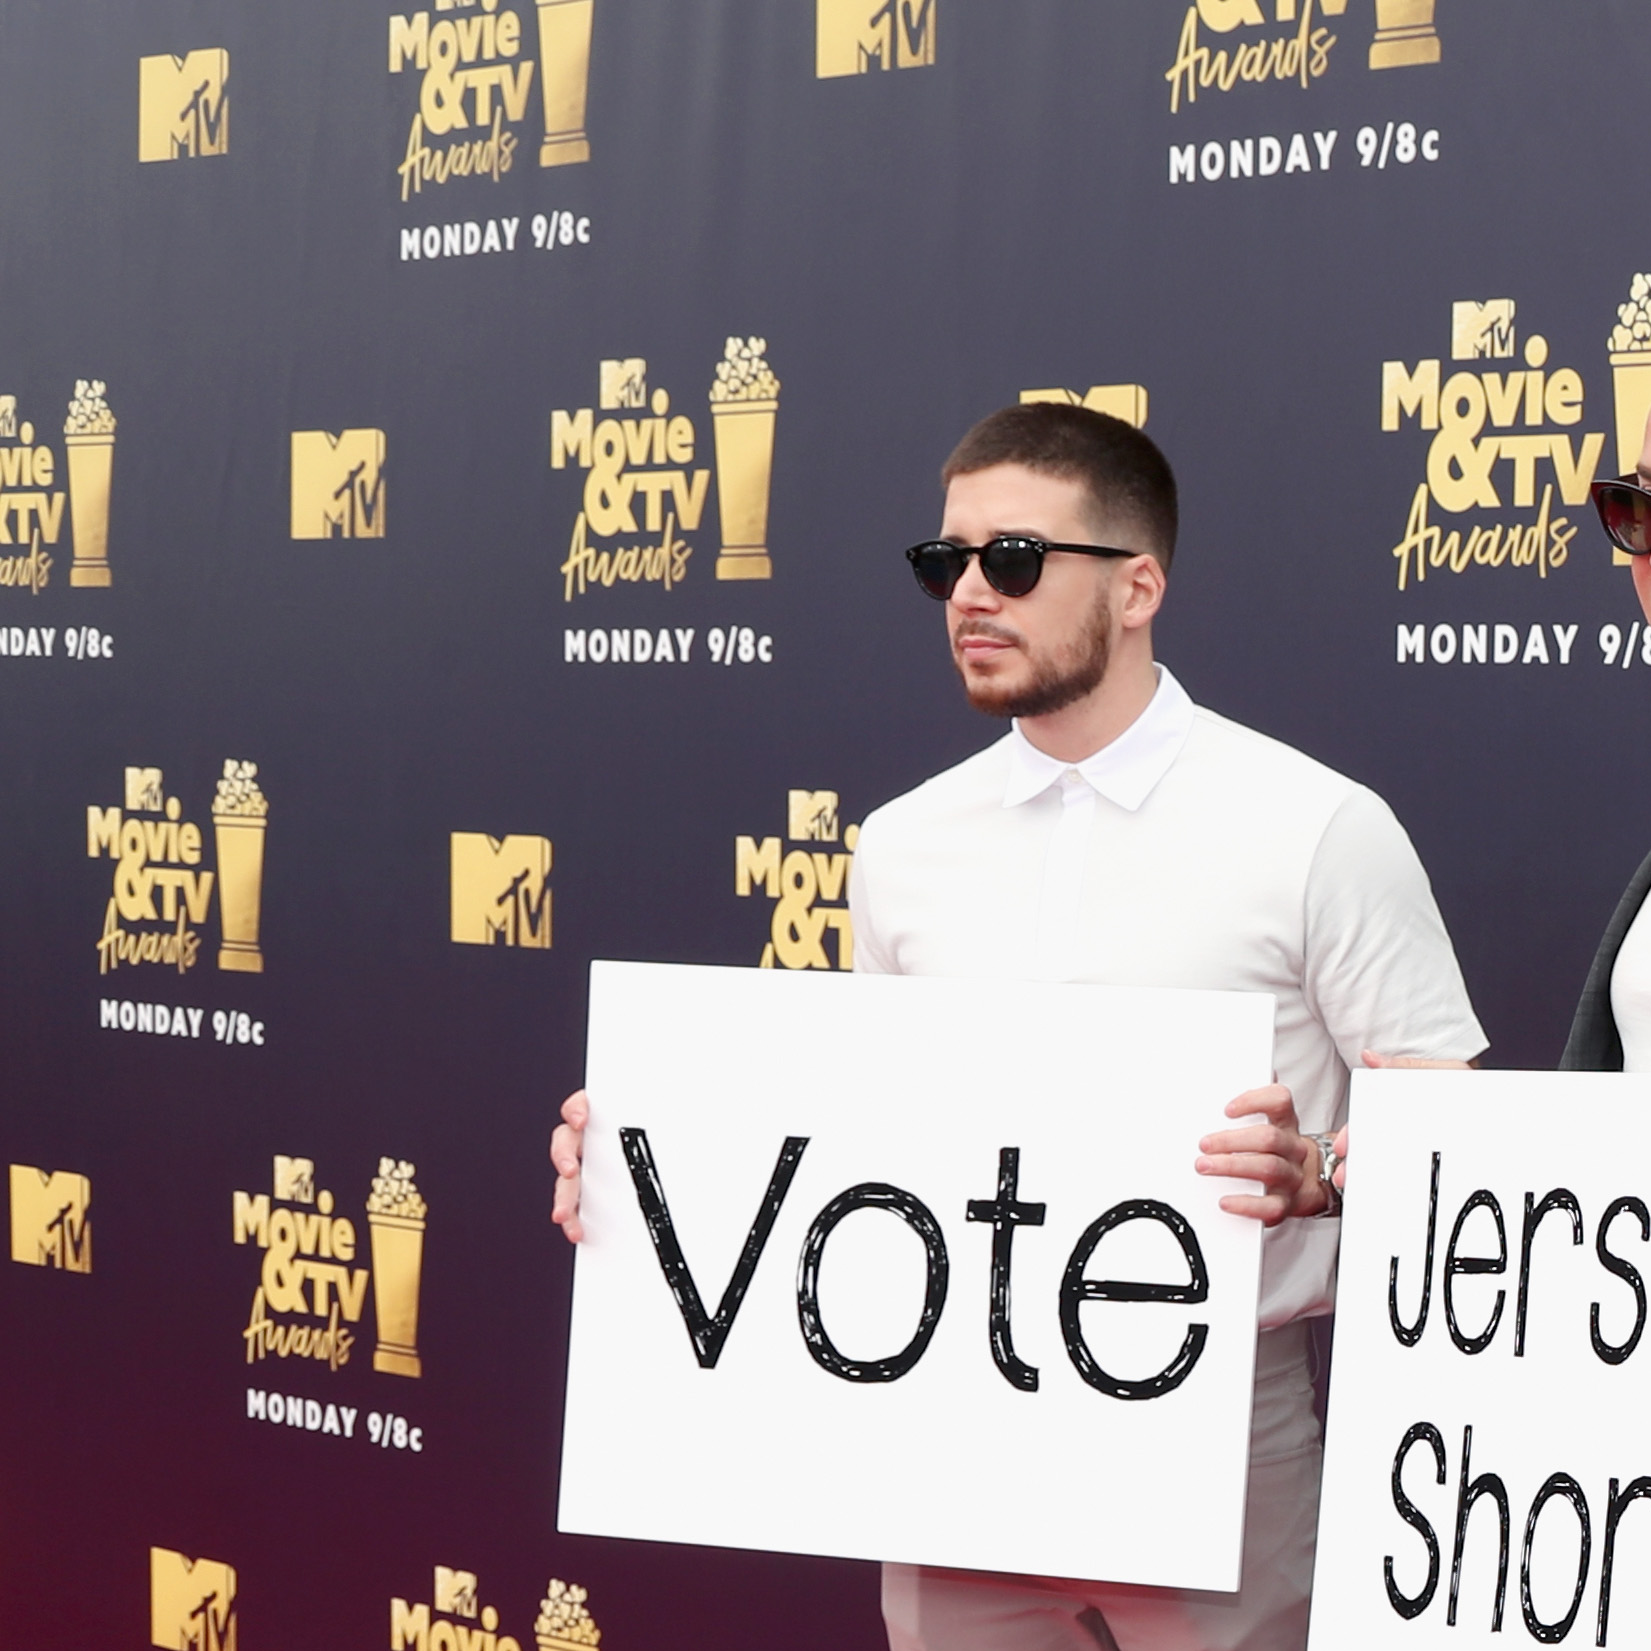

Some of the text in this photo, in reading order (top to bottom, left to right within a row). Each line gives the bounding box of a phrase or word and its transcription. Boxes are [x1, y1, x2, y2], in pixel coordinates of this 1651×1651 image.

[389, 0, 521, 73] Movie
[1165, 0, 1336, 113] Awards
[139, 47, 229, 163] MTV
[397, 105, 518, 202] Awards
[1169, 121, 1440, 183] MONDAY 9/8c
[400, 211, 590, 260] MONDAY 9/8c
[1451, 298, 1515, 360] MTV
[1381, 335, 1583, 433] Movie
[0, 421, 54, 486] vie
[551, 388, 695, 470] Movie
[291, 428, 385, 539] MTV
[0, 528, 52, 595] ards
[560, 511, 693, 602] Awards
[1393, 485, 1578, 591] Awards
[64, 626, 114, 660] 9/8c
[564, 625, 773, 665] MONDAY 9/8c
[1396, 622, 1579, 666] MONDAY
[87, 797, 202, 864] Movie
[735, 824, 860, 898] Movi
[451, 831, 552, 948] MTV
[96, 897, 201, 975] Awards
[771, 907, 854, 970] &T
[100, 999, 265, 1045] MONDAY 9/8c
[9, 1164, 92, 1274] MTV
[233, 1189, 356, 1261] Movie
[619, 1126, 1209, 1402] Vote
[243, 1286, 355, 1372] Awards
[246, 1388, 423, 1452] MONDAY 9/8c
